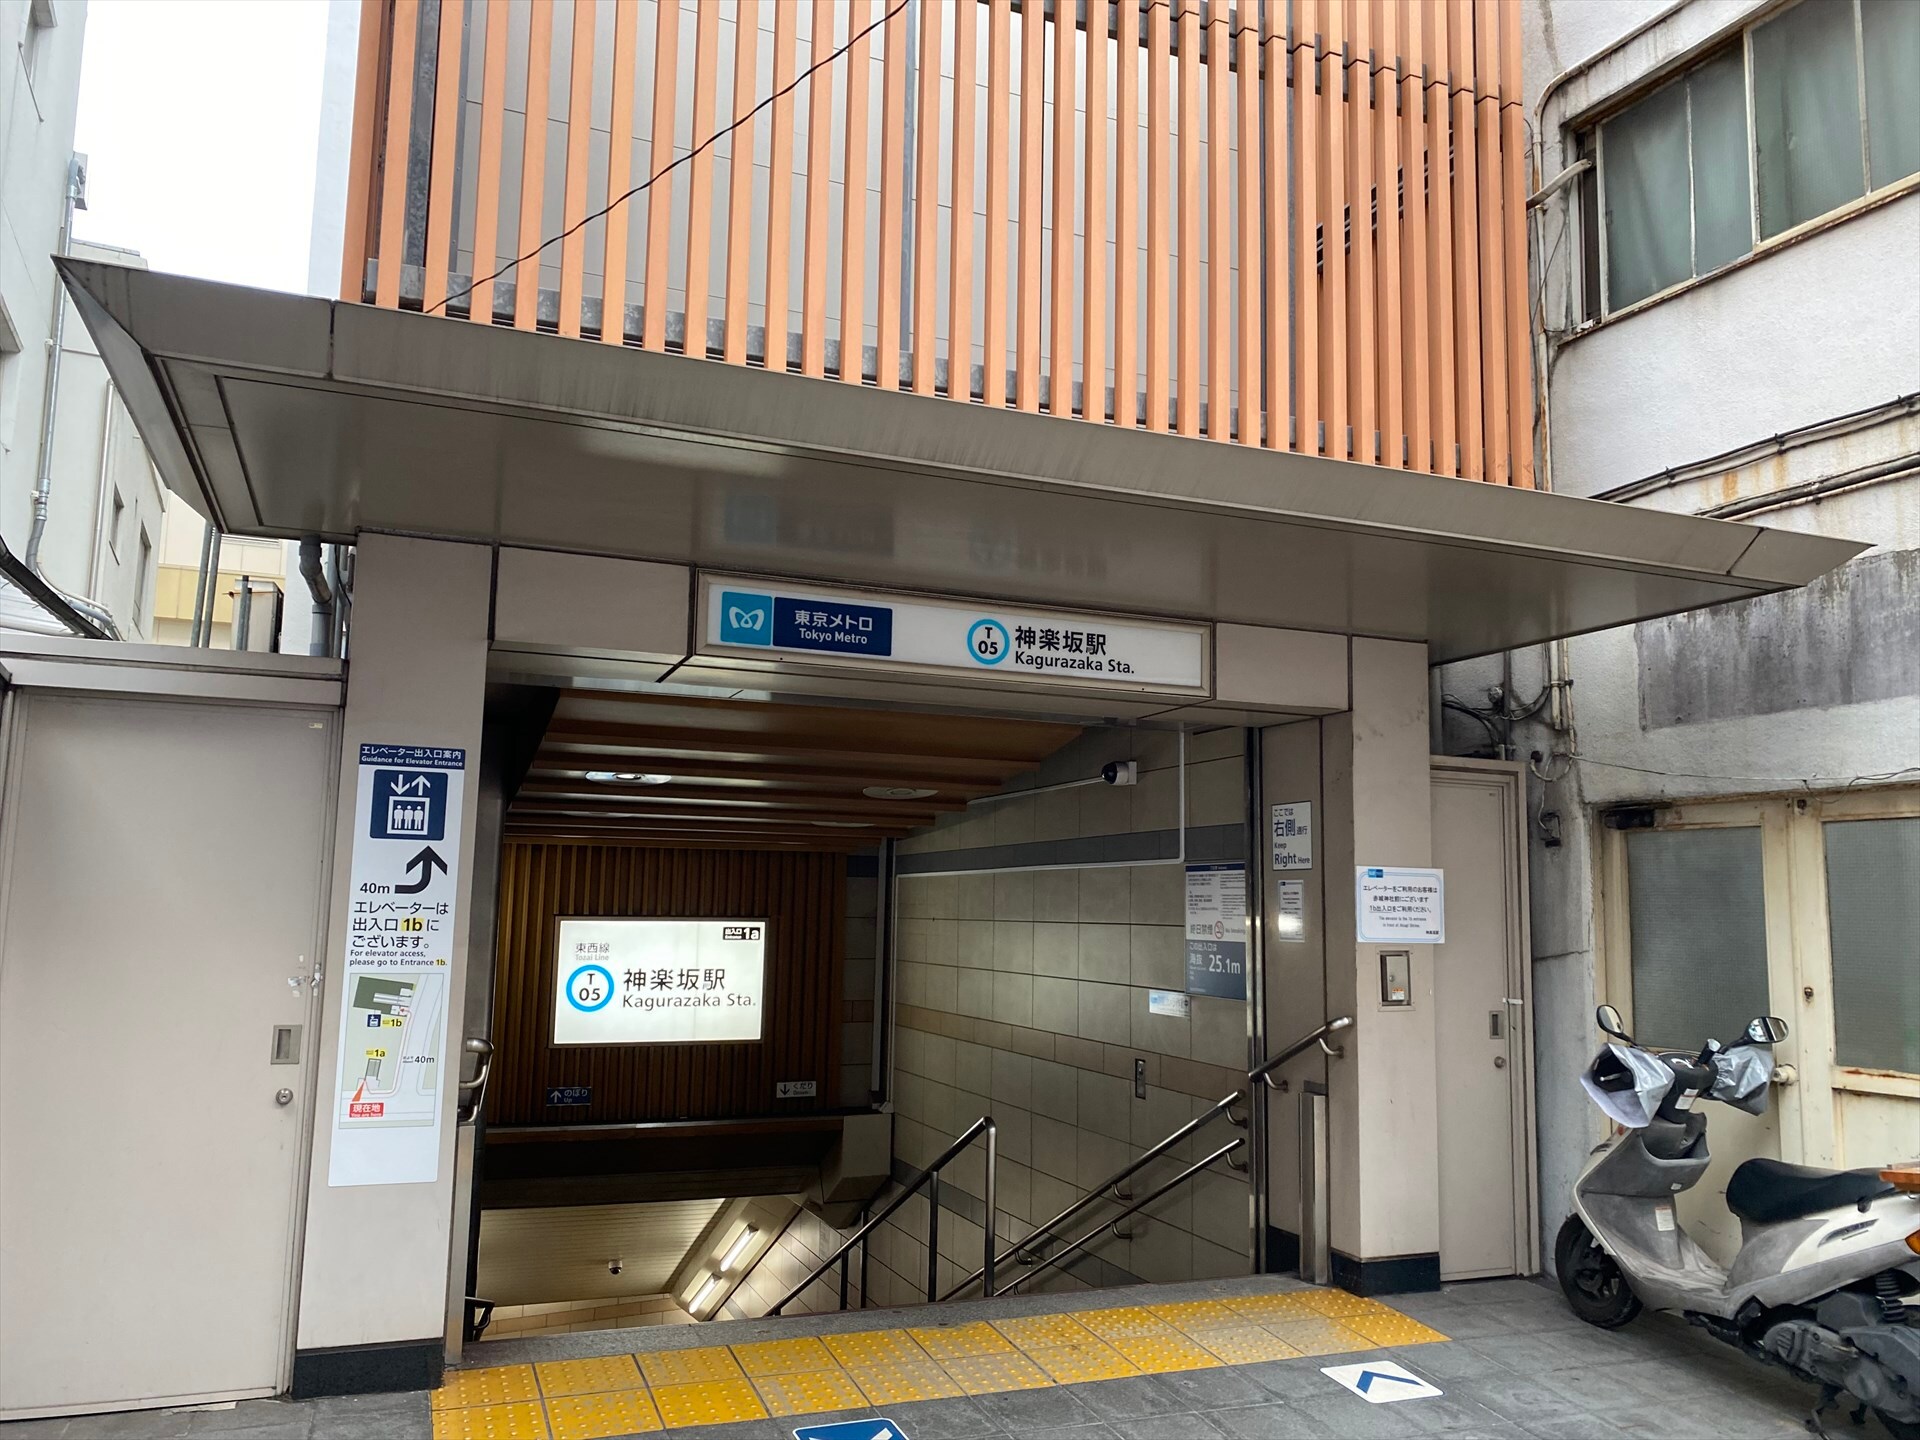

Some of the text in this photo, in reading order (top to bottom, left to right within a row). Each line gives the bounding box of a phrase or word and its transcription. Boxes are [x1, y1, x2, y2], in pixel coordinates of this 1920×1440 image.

[794, 610, 872, 631] 東京メトロ
[799, 628, 868, 644] Tokyo Metro
[985, 626, 993, 639] T
[1015, 625, 1107, 656] 神楽坂駅
[978, 640, 998, 655] 05
[1015, 650, 1135, 674] Kagurazaka Sta.
[362, 746, 462, 760] エレベーター出入口案内
[405, 757, 433, 765] Elevator
[434, 759, 463, 767] Entrance
[1274, 842, 1287, 850] Keep
[1275, 852, 1310, 868] Right Here
[360, 882, 390, 894] 40m
[354, 901, 449, 915] エレベーターは
[352, 917, 440, 932] 出入口 1b に
[743, 927, 759, 940] 1a
[352, 934, 429, 949] ございます。
[575, 942, 610, 954] 東西線
[349, 958, 375, 967] please
[575, 953, 609, 961] Tozai Line
[1208, 954, 1241, 974] 25.1m
[587, 973, 596, 985] T
[623, 968, 725, 992] 神楽坂駅
[578, 988, 601, 1001] 05
[622, 992, 756, 1011] Kagurazaka Sta.
[391, 1018, 402, 1027] 1b
[374, 1049, 386, 1057] 1a
[414, 1056, 435, 1064] 40m
[793, 1082, 813, 1090] くだり
[563, 1089, 588, 1097] のぼり
[352, 1104, 381, 1113] 現在地
